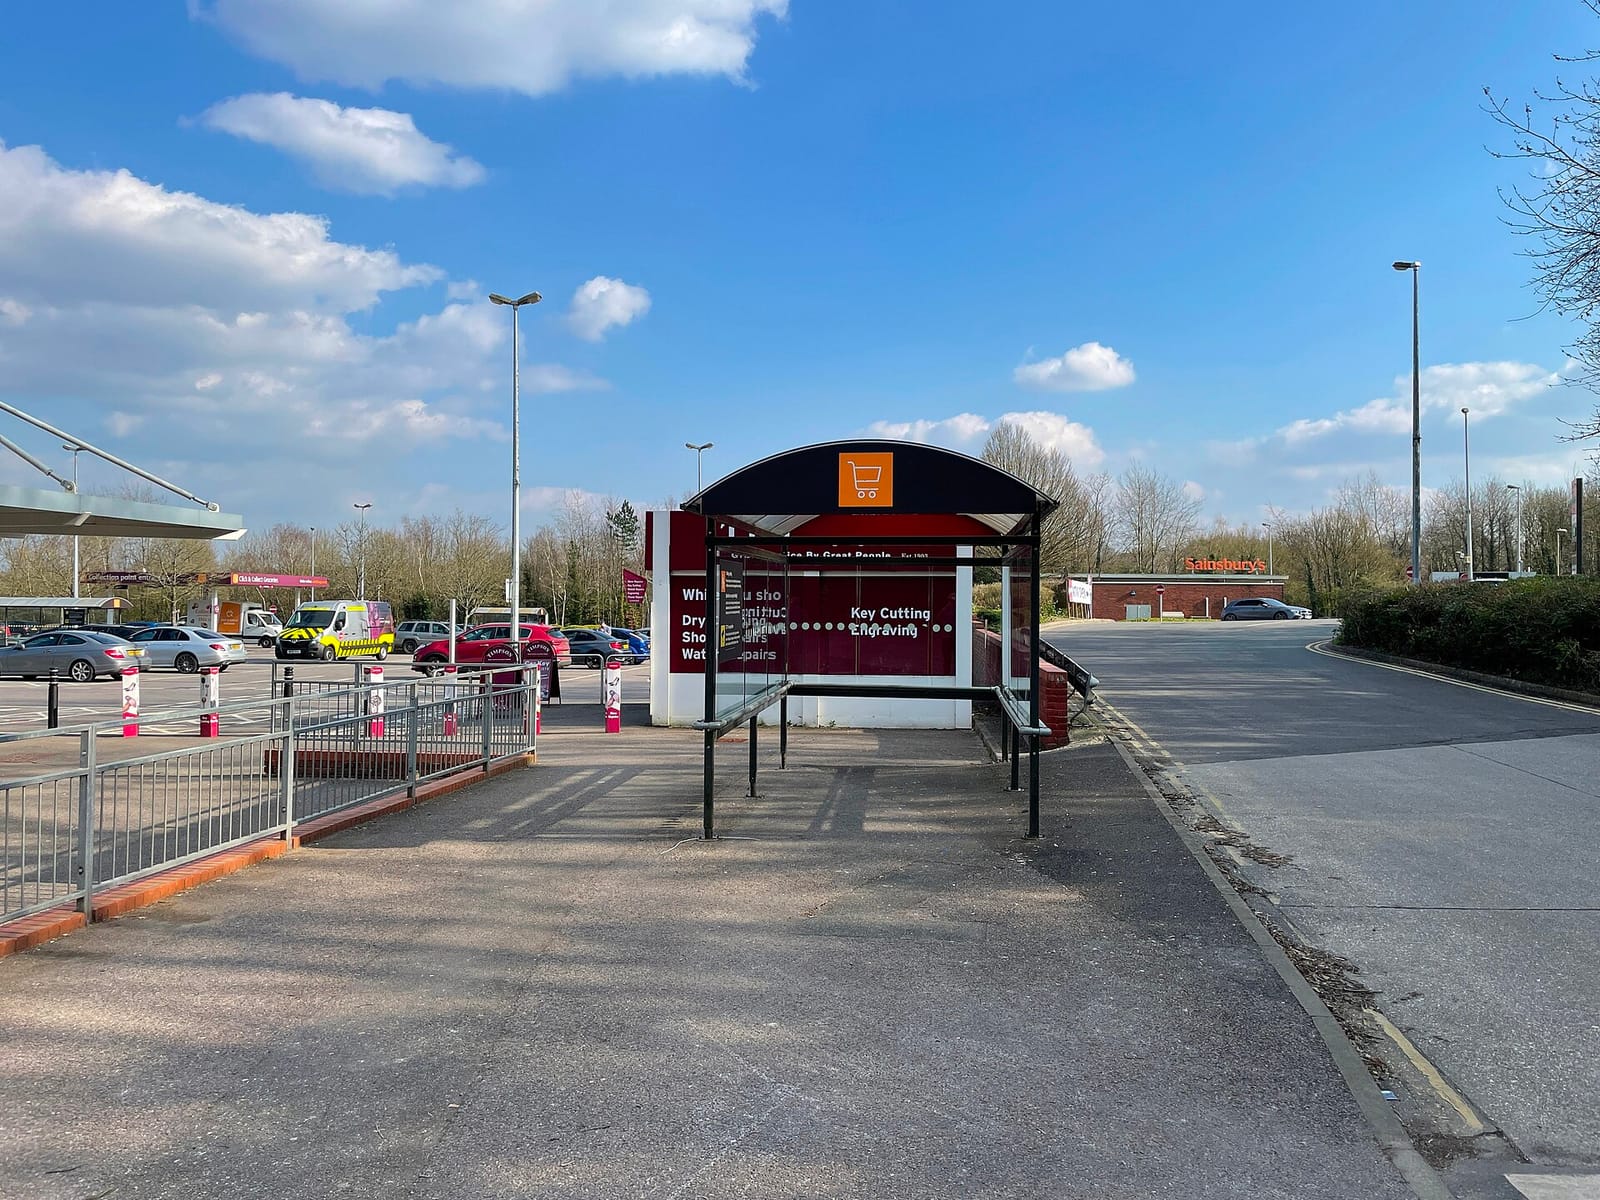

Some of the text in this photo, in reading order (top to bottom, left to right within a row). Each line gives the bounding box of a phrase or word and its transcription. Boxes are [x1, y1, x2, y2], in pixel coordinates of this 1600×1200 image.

[1185, 557, 1266, 574] Sainsbury's
[682, 588, 707, 601] Whi
[756, 588, 782, 601] sho
[682, 614, 706, 628] Dry
[851, 607, 931, 622] Key Cutting
[682, 631, 707, 643] Sho
[851, 624, 918, 639] Engraving
[487, 648, 513, 658] TIMPSON
[527, 643, 550, 653] TIMPSON
[682, 648, 707, 660] Wat
